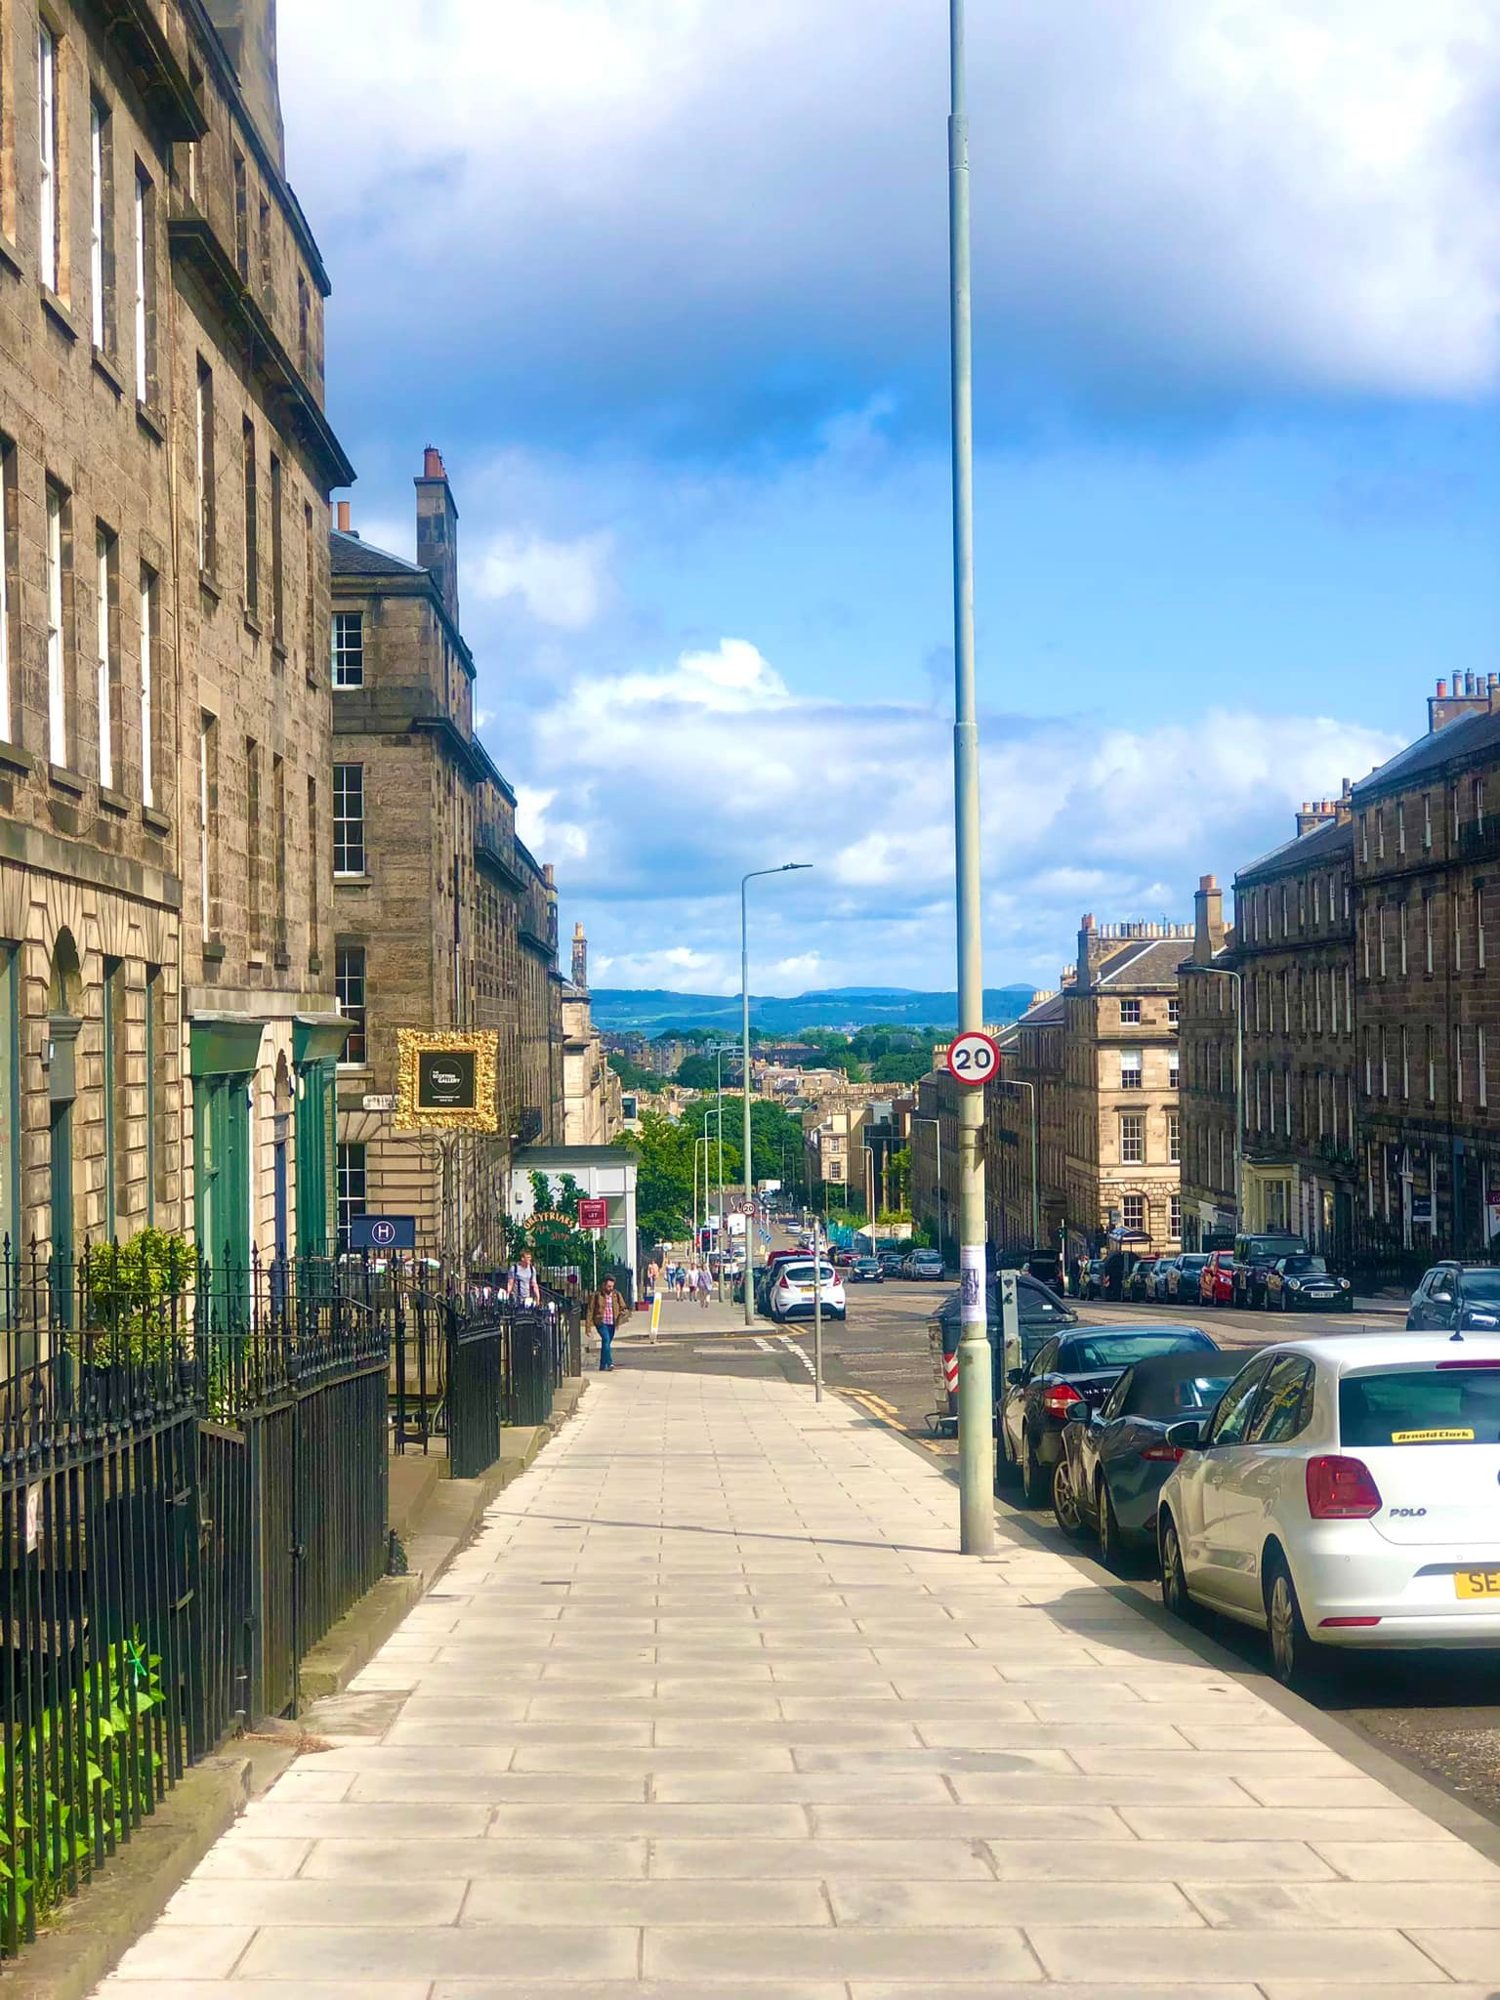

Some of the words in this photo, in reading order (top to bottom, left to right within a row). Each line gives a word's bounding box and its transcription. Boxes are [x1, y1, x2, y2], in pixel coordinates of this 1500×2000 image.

[955, 1047, 991, 1070] 20
[523, 1212, 575, 1229] GREYFRIARS
[378, 1225, 389, 1238] H
[1398, 1432, 1437, 1441] Arnold
[1439, 1431, 1469, 1439] Clark
[1389, 1507, 1427, 1518] POLO
[1468, 1572, 1500, 1593] SE
